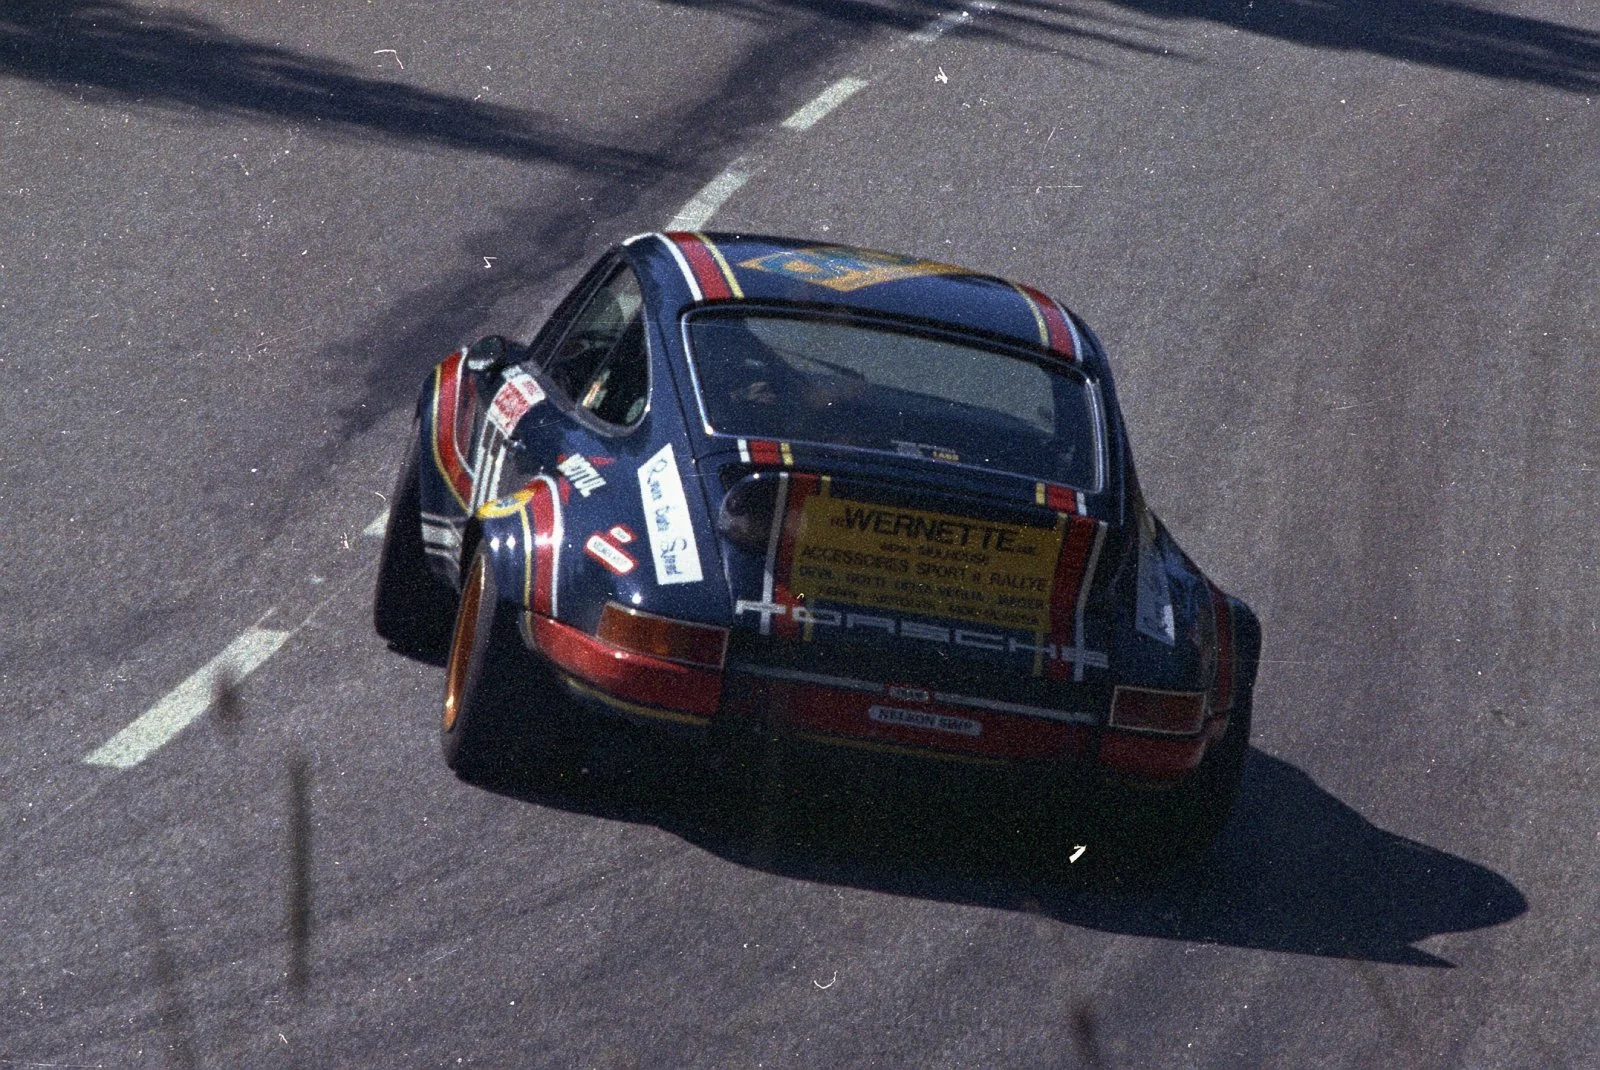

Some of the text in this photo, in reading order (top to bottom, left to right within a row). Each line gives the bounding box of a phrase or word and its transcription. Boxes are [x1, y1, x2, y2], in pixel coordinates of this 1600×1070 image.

[844, 507, 1018, 549] WERNETTE
[915, 561, 966, 581] SPORT
[989, 570, 1046, 591] RALLYE
[735, 600, 1110, 670] PORSCHE
